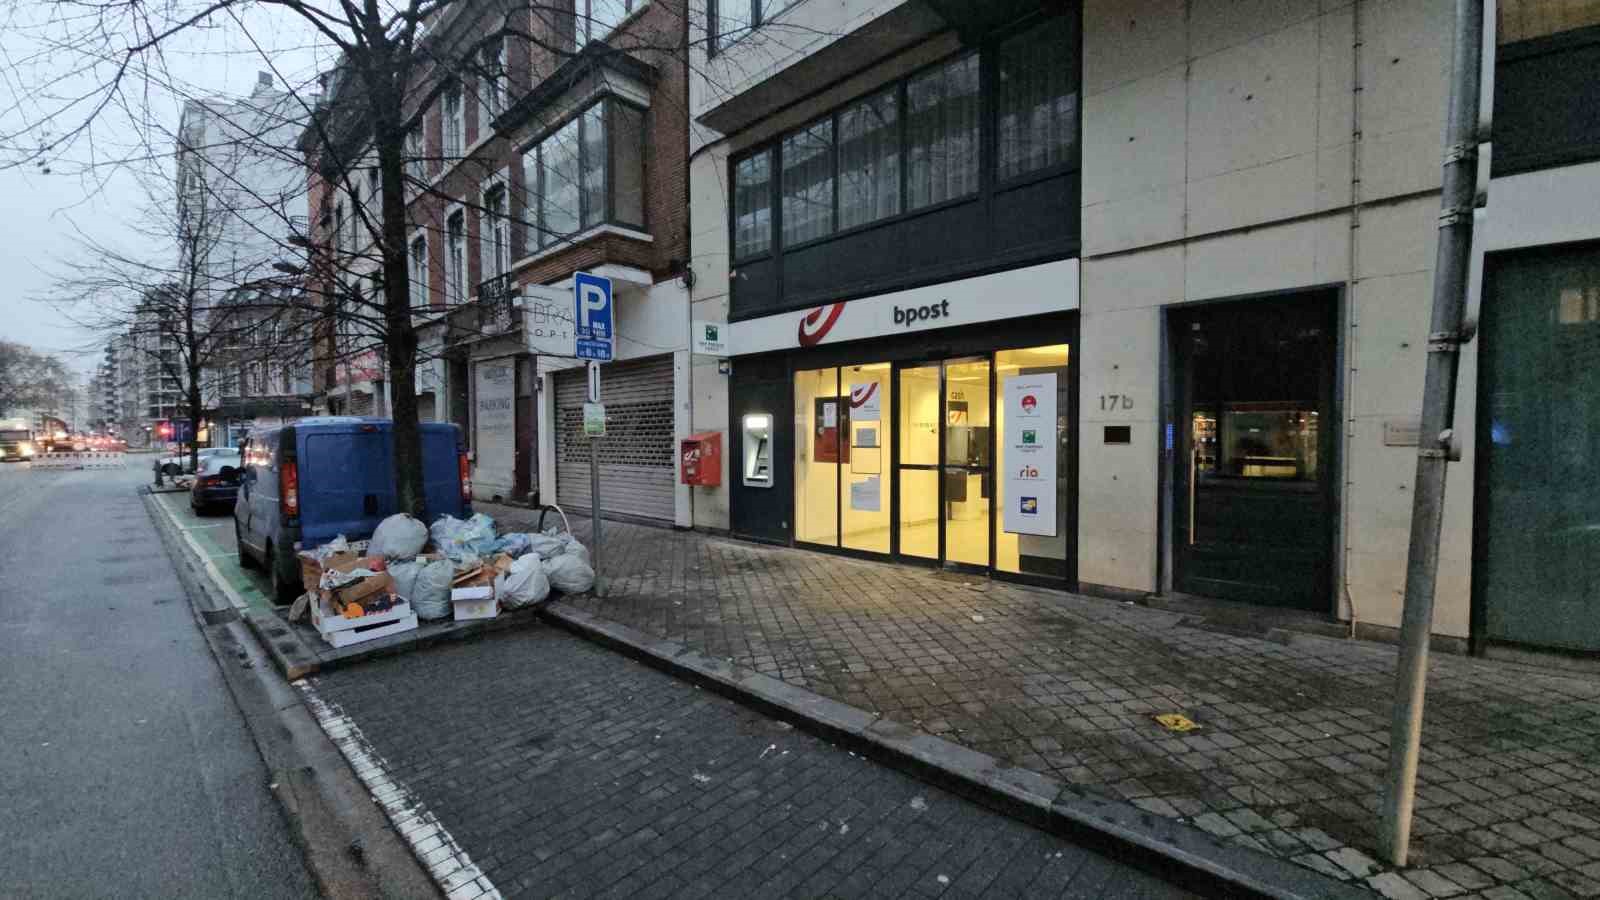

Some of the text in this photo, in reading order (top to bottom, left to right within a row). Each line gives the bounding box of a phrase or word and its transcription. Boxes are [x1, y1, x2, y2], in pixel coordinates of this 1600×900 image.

[580, 282, 607, 327] P
[893, 299, 949, 327] bpost
[592, 320, 605, 329] MAX
[1100, 394, 1134, 411] 17b
